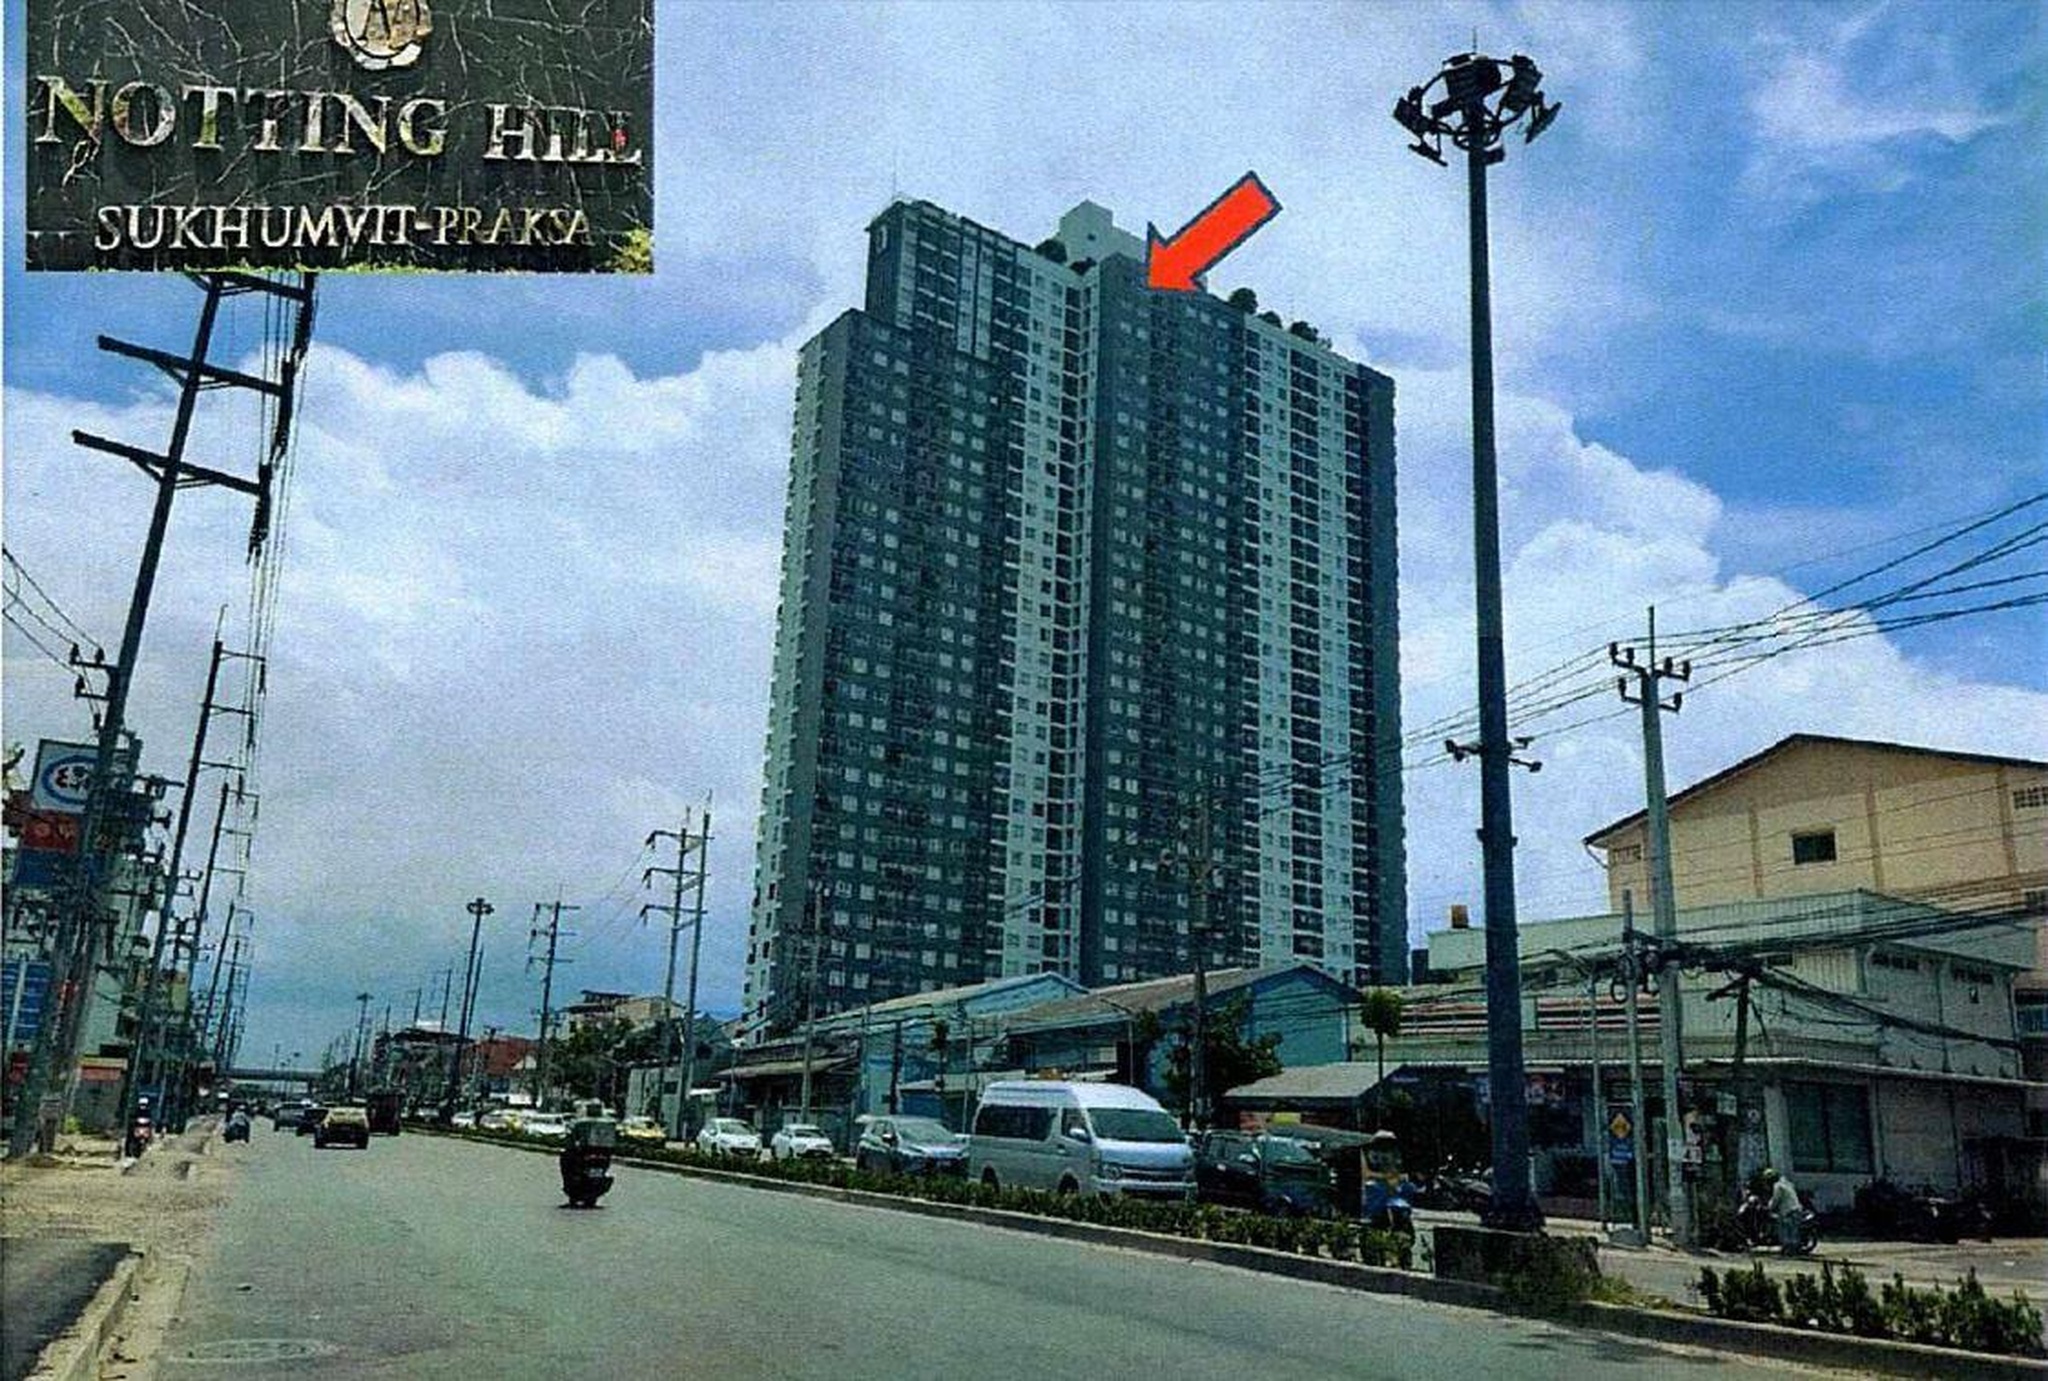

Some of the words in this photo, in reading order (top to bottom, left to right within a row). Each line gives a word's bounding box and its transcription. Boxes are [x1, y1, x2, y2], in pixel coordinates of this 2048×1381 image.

[34, 75, 448, 156] NOTTING
[482, 102, 642, 164] HILL
[94, 204, 594, 251] SUKHUMVIT-PRAKSA
